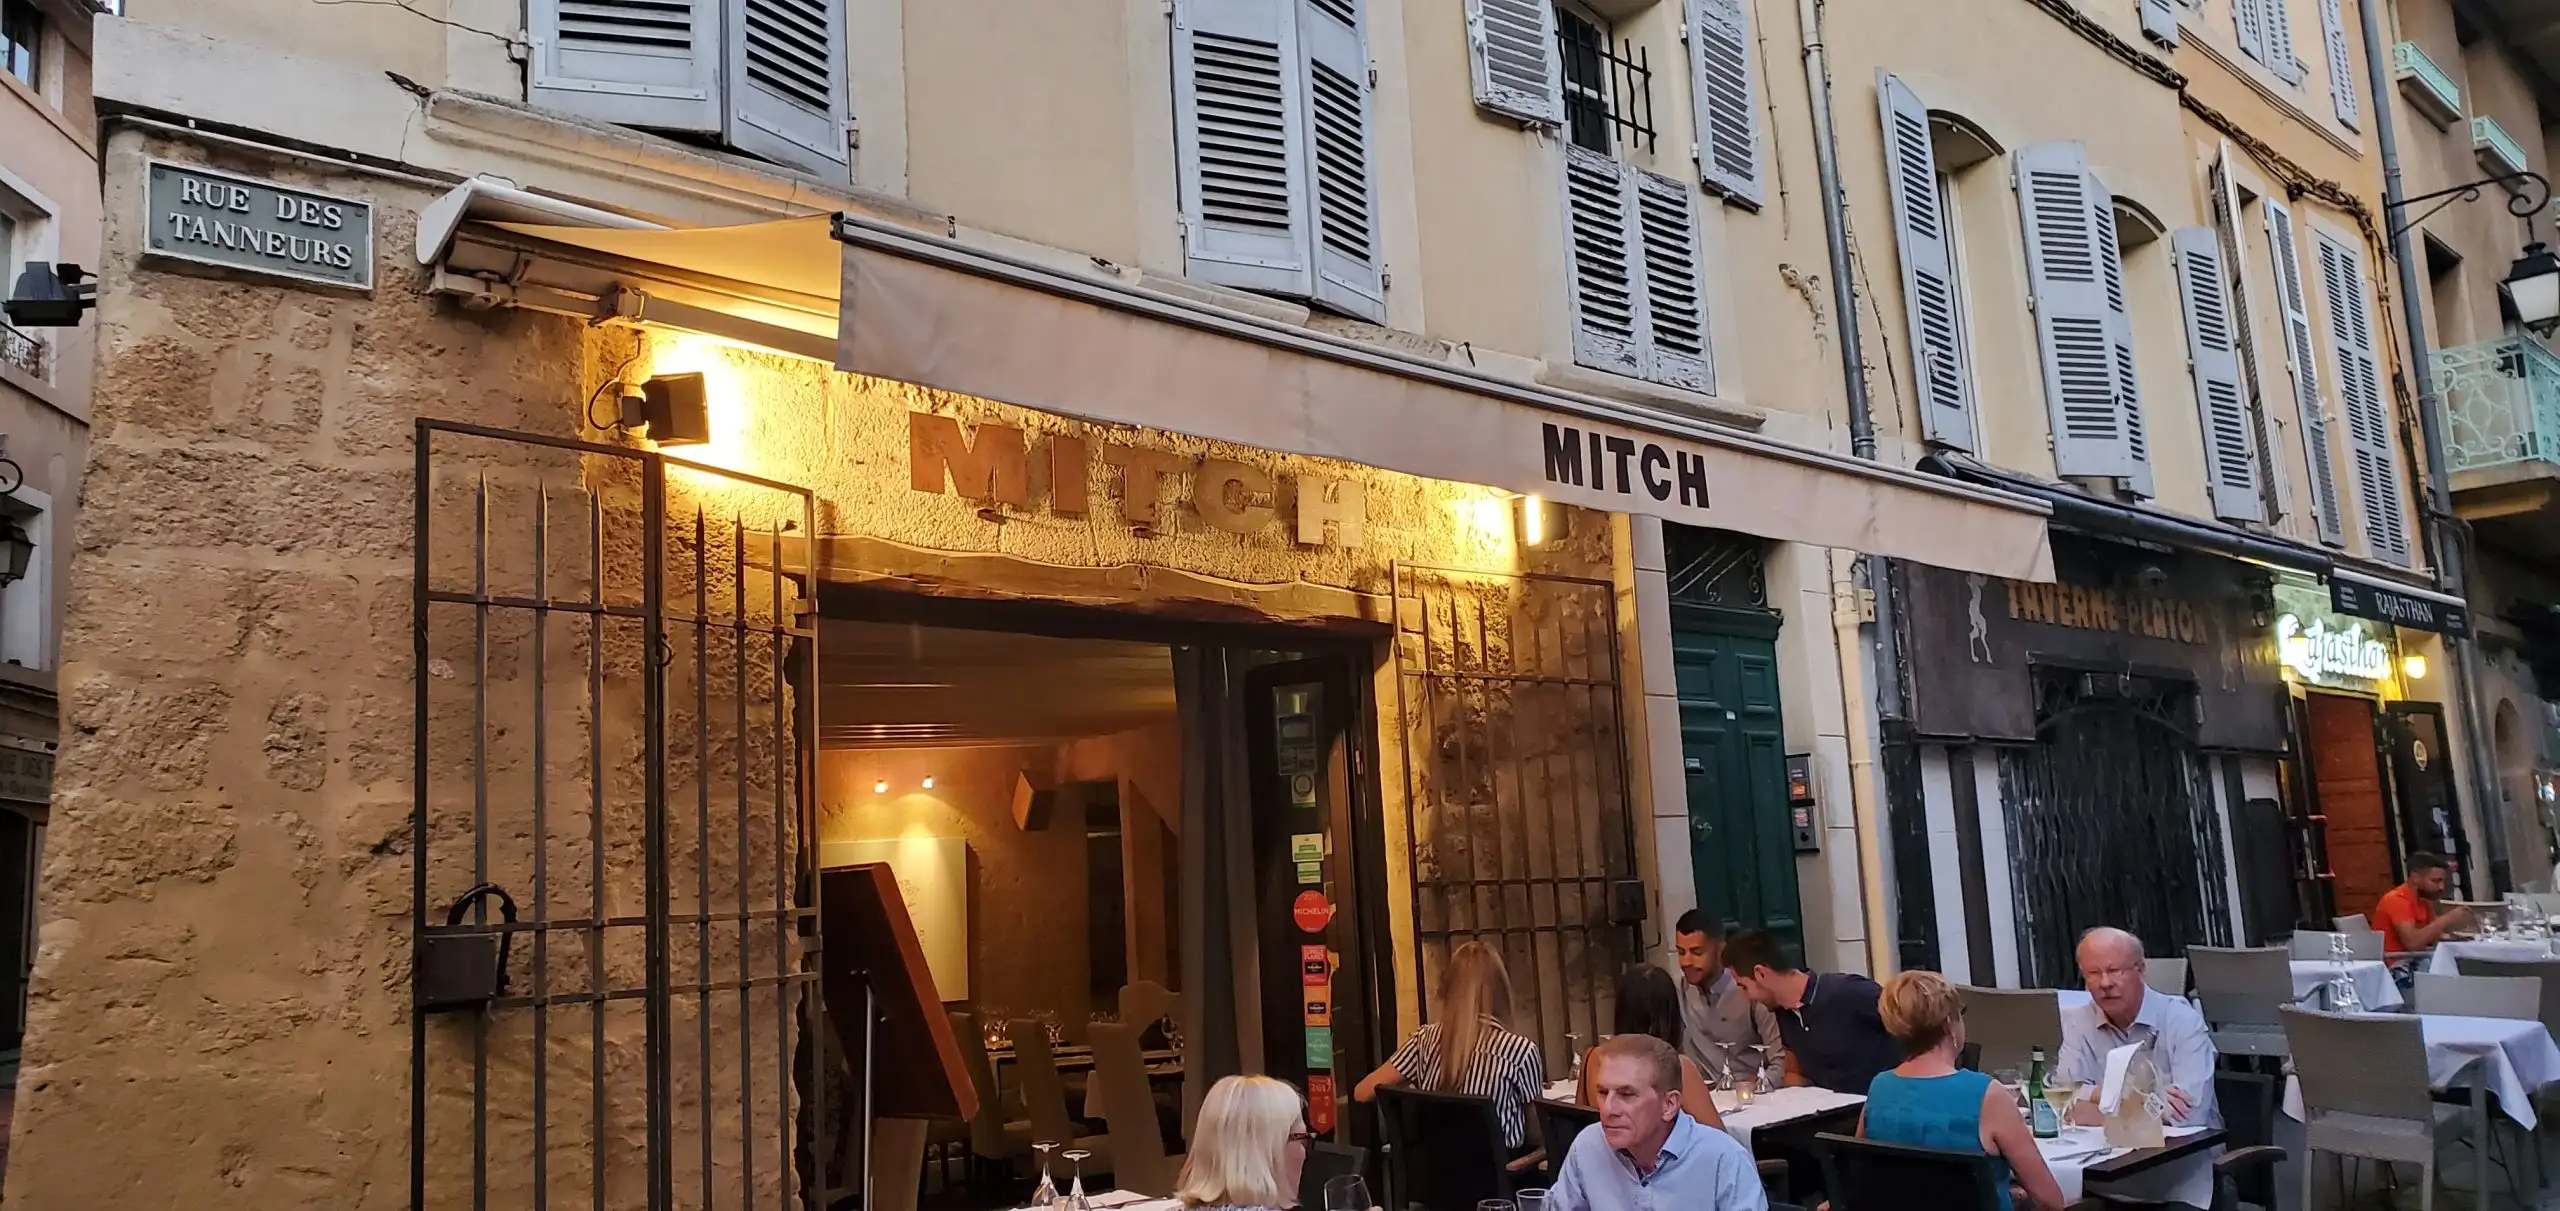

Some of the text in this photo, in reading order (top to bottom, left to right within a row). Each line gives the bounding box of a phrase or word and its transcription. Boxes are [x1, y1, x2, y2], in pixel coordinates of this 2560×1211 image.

[181, 177, 342, 229] RUE DES
[169, 212, 353, 268] TANNEURS
[909, 411, 1364, 548] MITCH
[1542, 422, 1710, 509] MITCH
[2006, 580, 2120, 632] TAVERNE
[2375, 592, 2434, 622] RAJASTHAN
